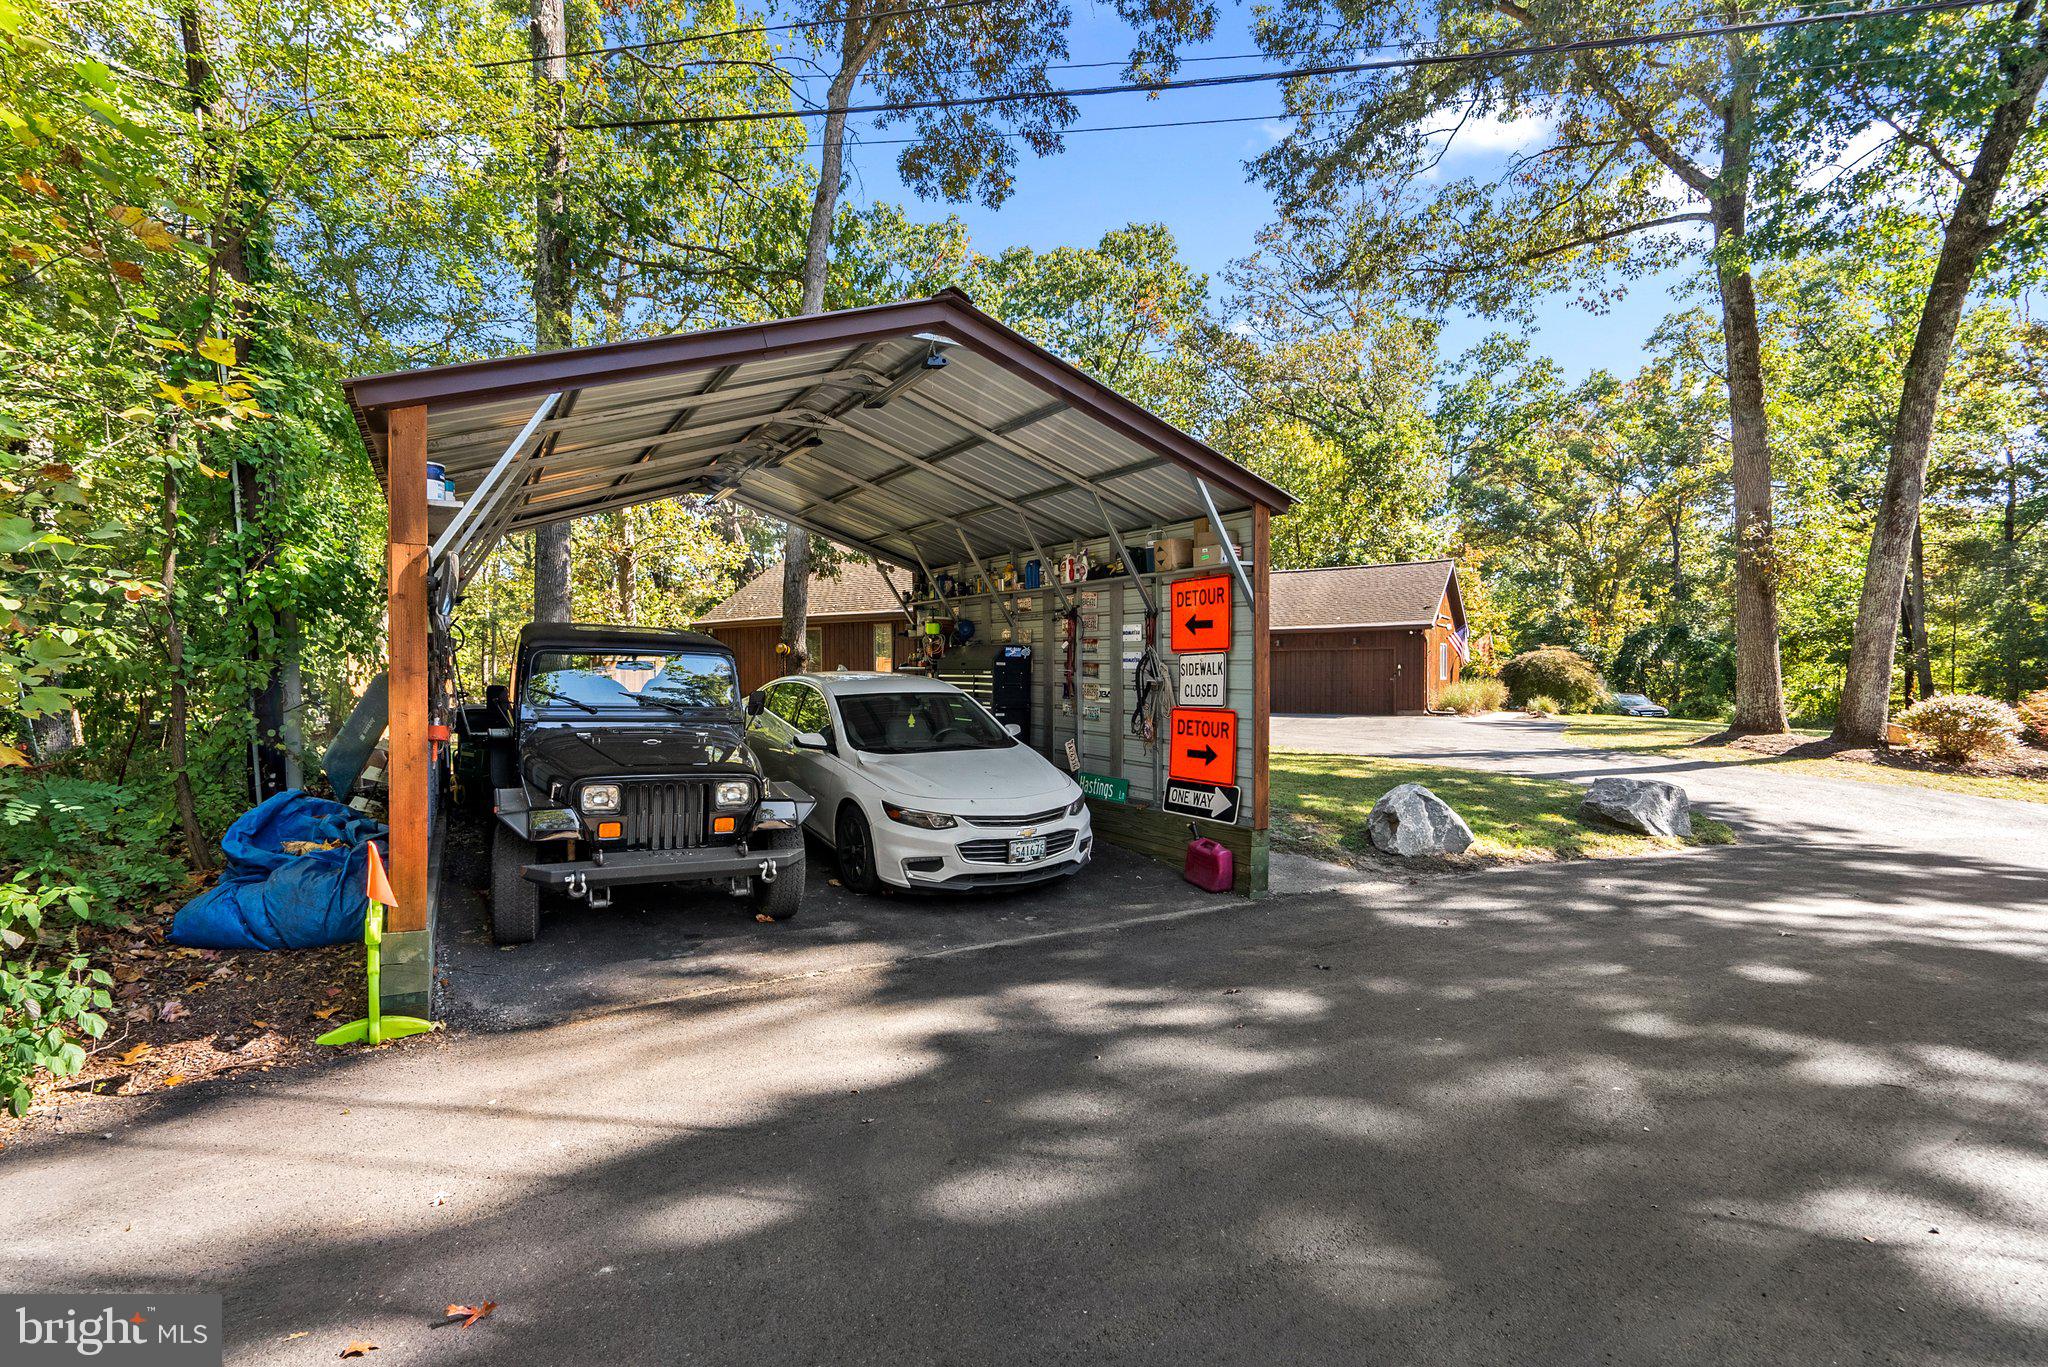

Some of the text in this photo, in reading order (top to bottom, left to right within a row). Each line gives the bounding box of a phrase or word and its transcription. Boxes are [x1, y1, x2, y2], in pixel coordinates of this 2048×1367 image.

[1176, 587, 1225, 607] DETOUR
[1180, 662, 1224, 676] SIDEWALK
[1184, 684, 1219, 698] CLOSED
[1177, 719, 1230, 739] DETOUR
[1080, 775, 1114, 800] Hastings
[1171, 789, 1214, 808] ONE WAY
